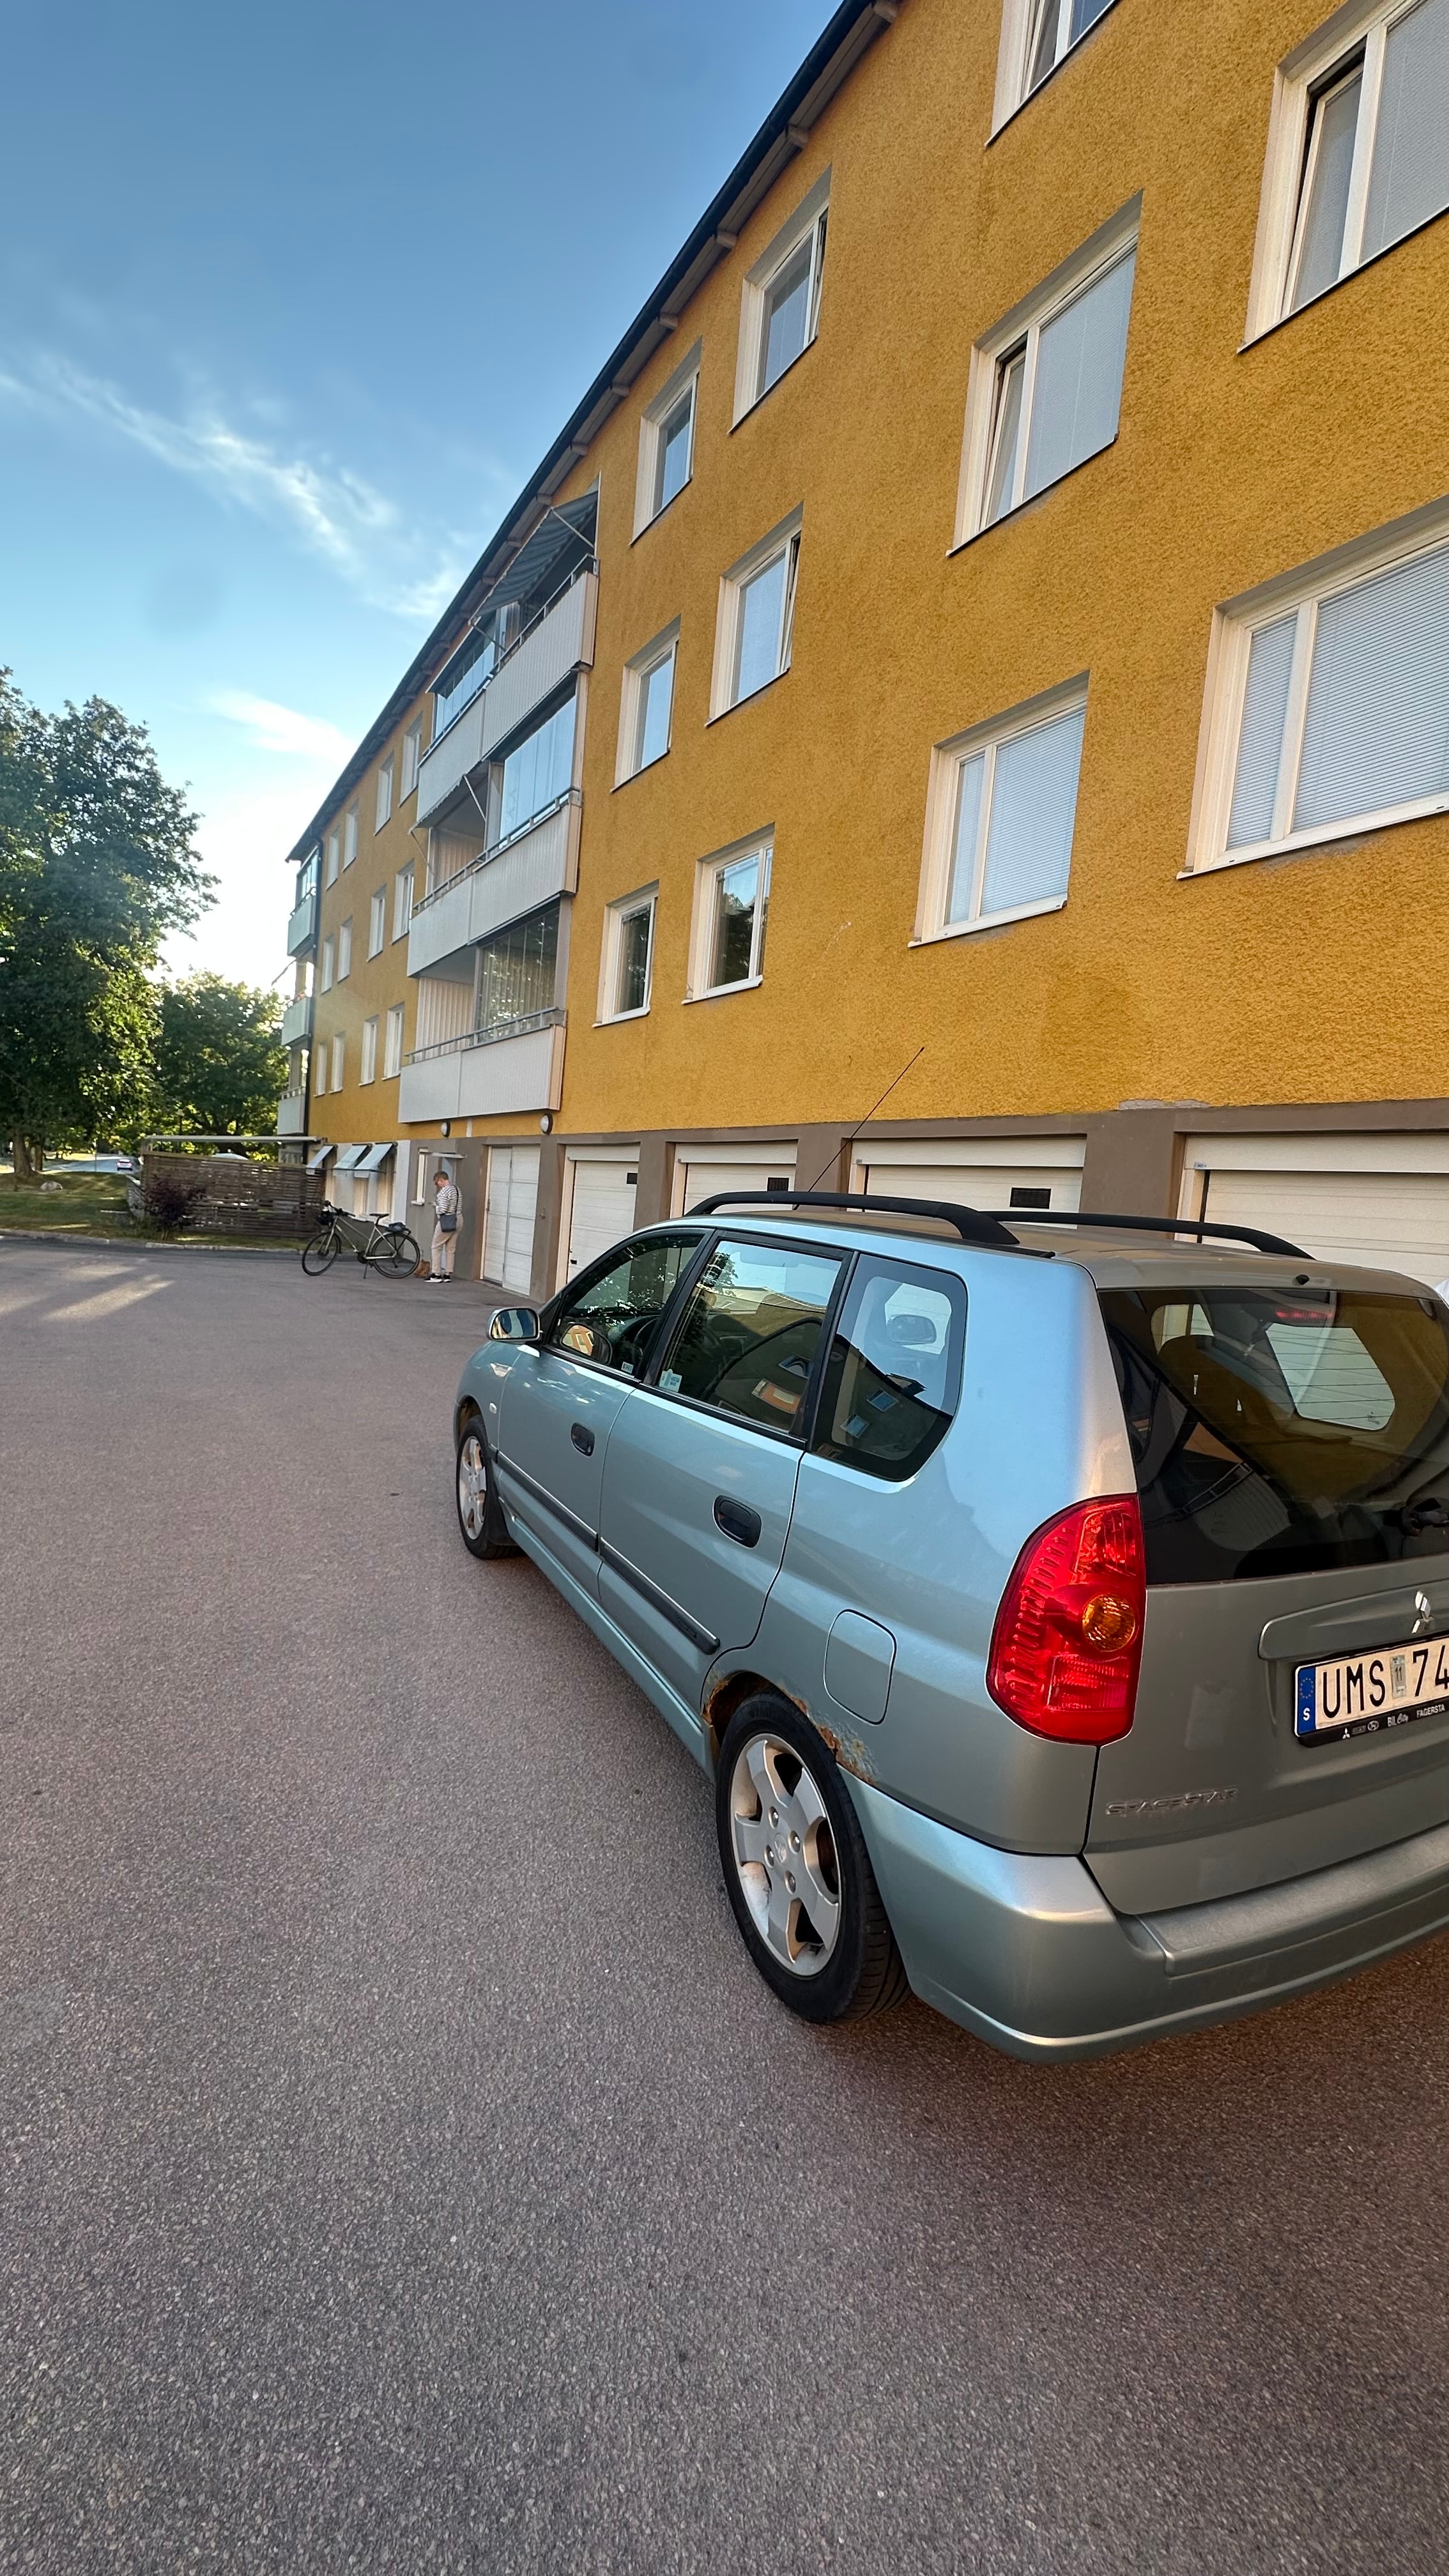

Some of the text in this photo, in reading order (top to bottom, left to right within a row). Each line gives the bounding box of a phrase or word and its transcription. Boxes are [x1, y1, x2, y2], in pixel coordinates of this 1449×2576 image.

[1322, 1659, 1386, 1719] UMS
[1303, 1707, 1310, 1721] S
[1416, 1703, 1445, 1719] FAGERSTA
